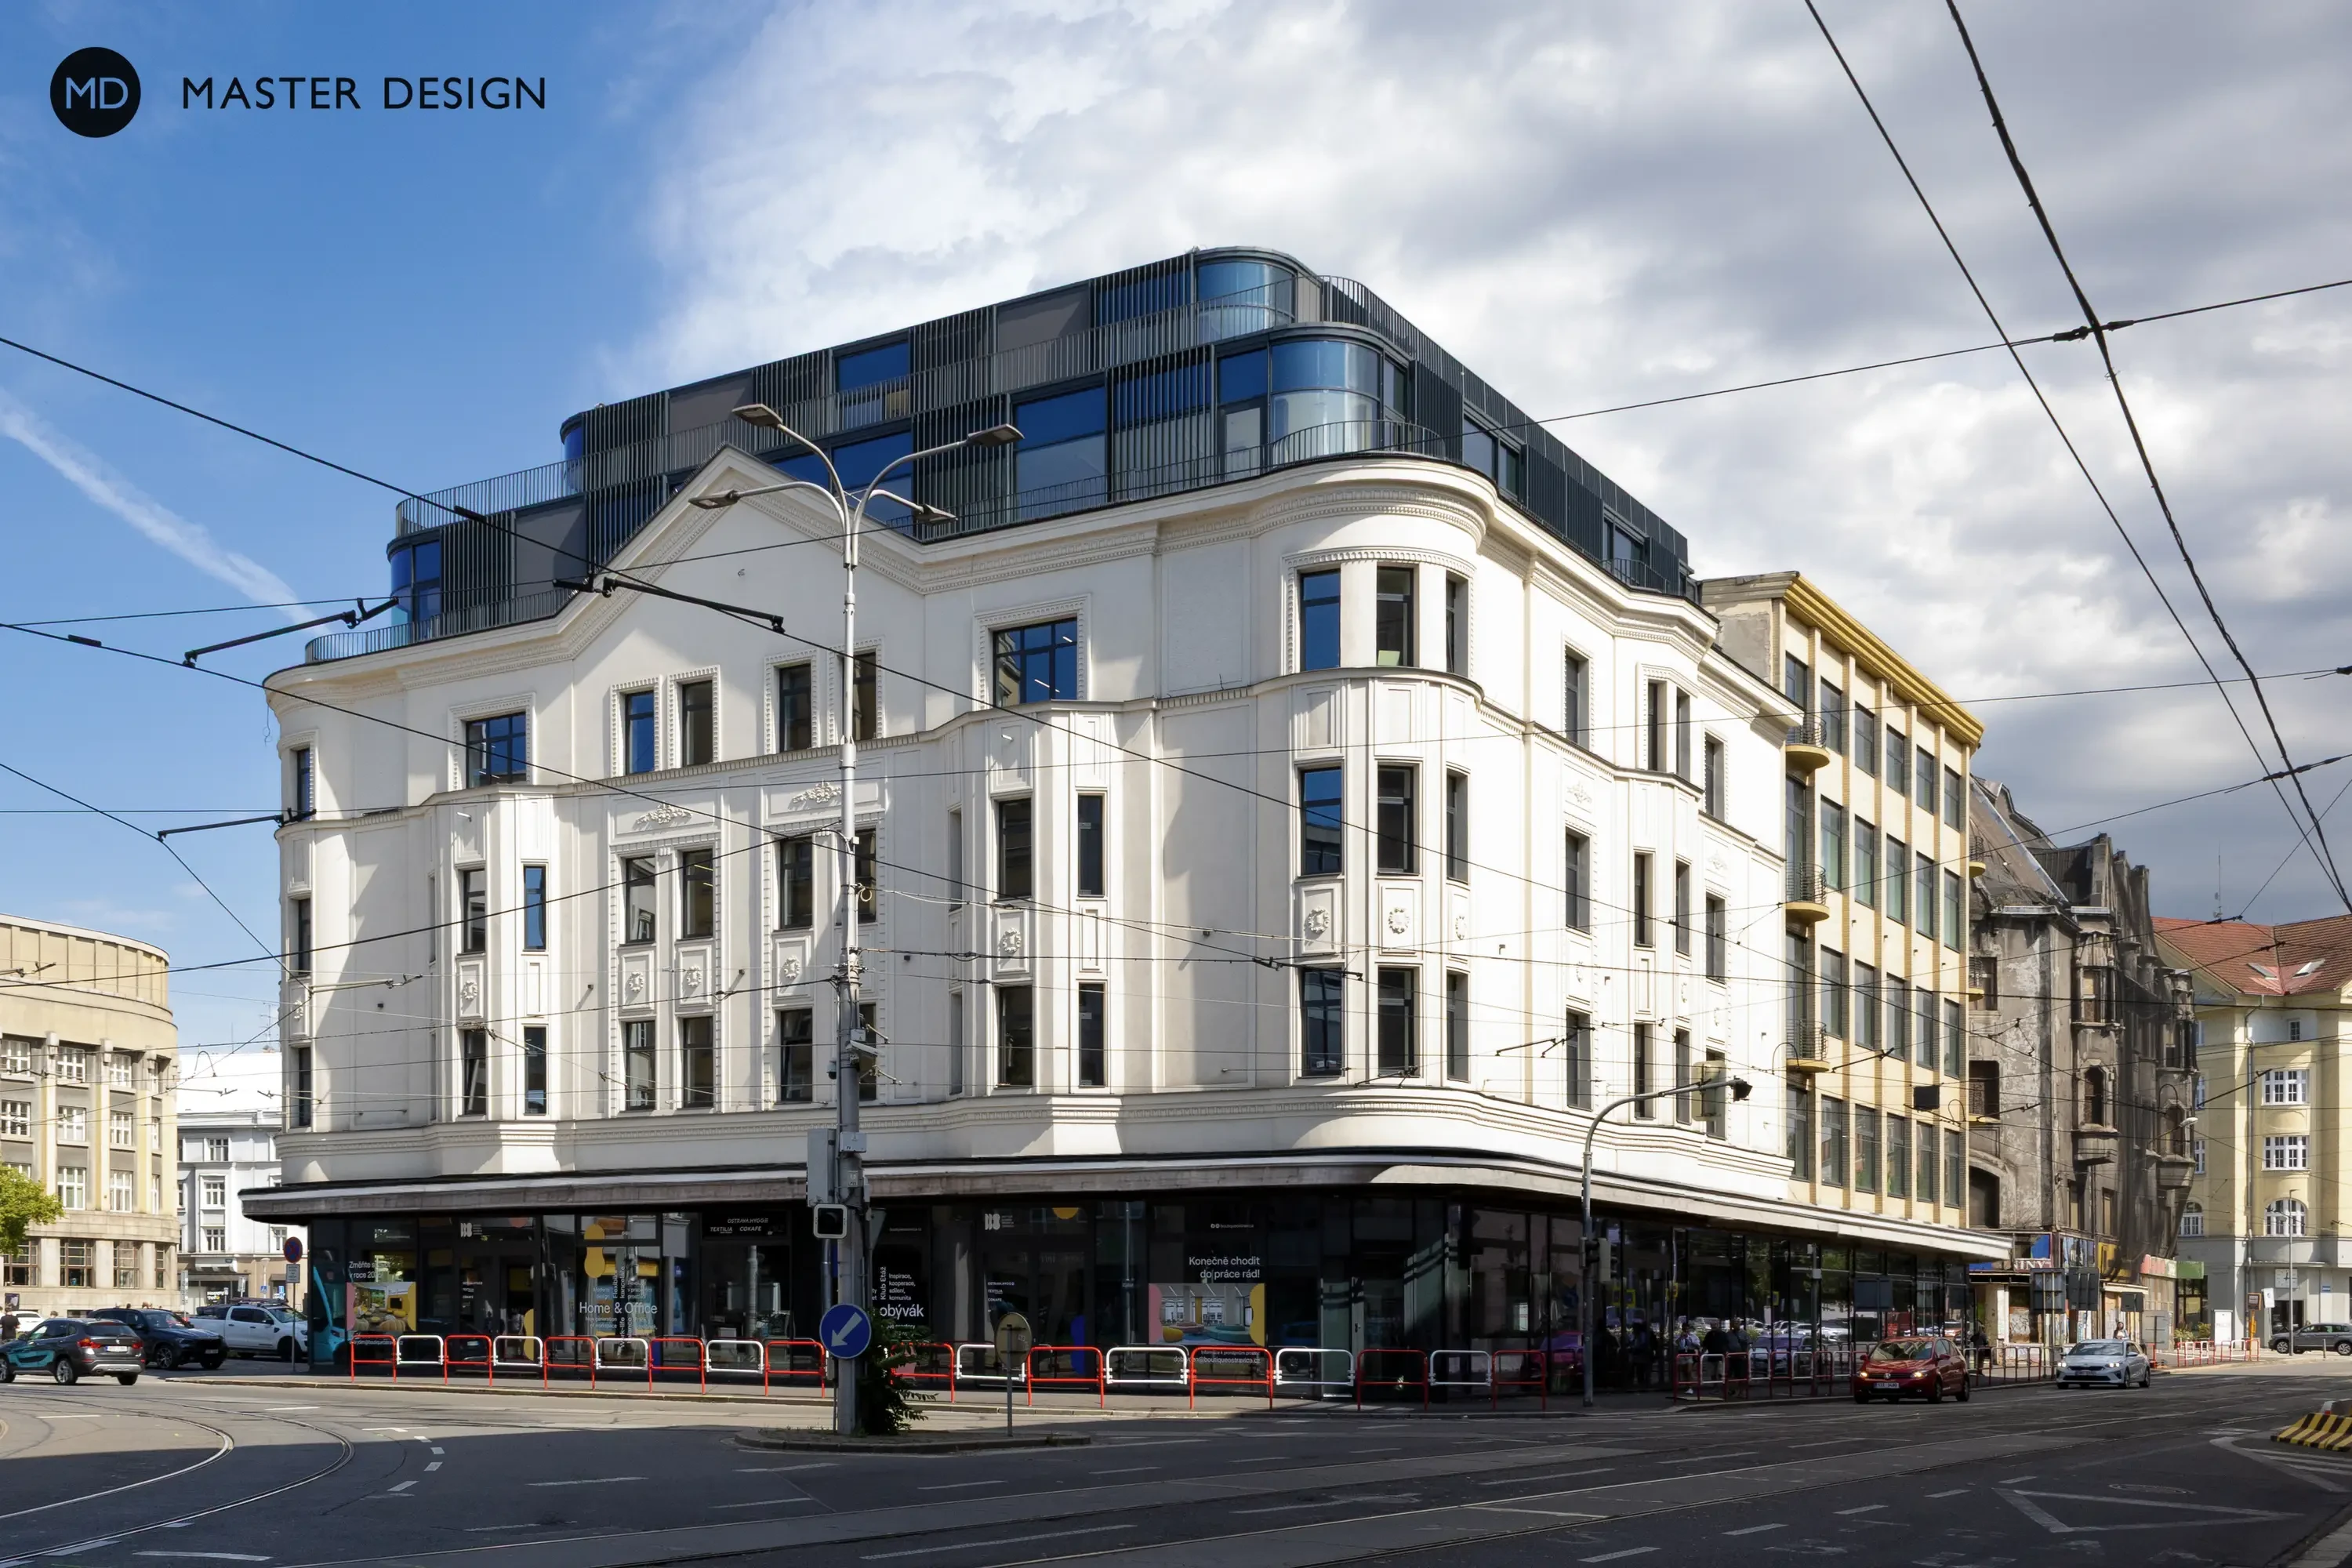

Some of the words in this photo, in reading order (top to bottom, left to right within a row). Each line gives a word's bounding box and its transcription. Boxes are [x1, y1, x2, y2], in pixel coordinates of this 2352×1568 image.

[1189, 1256, 1229, 1265] Konečně
[1230, 1256, 1261, 1265] chodit
[1200, 1269, 1212, 1279] do
[1214, 1269, 1240, 1280] práce
[1242, 1269, 1260, 1279] rád!
[579, 1302, 611, 1313] Home
[614, 1302, 622, 1313] &
[624, 1301, 658, 1314] Office
[879, 1304, 924, 1320] obývák
